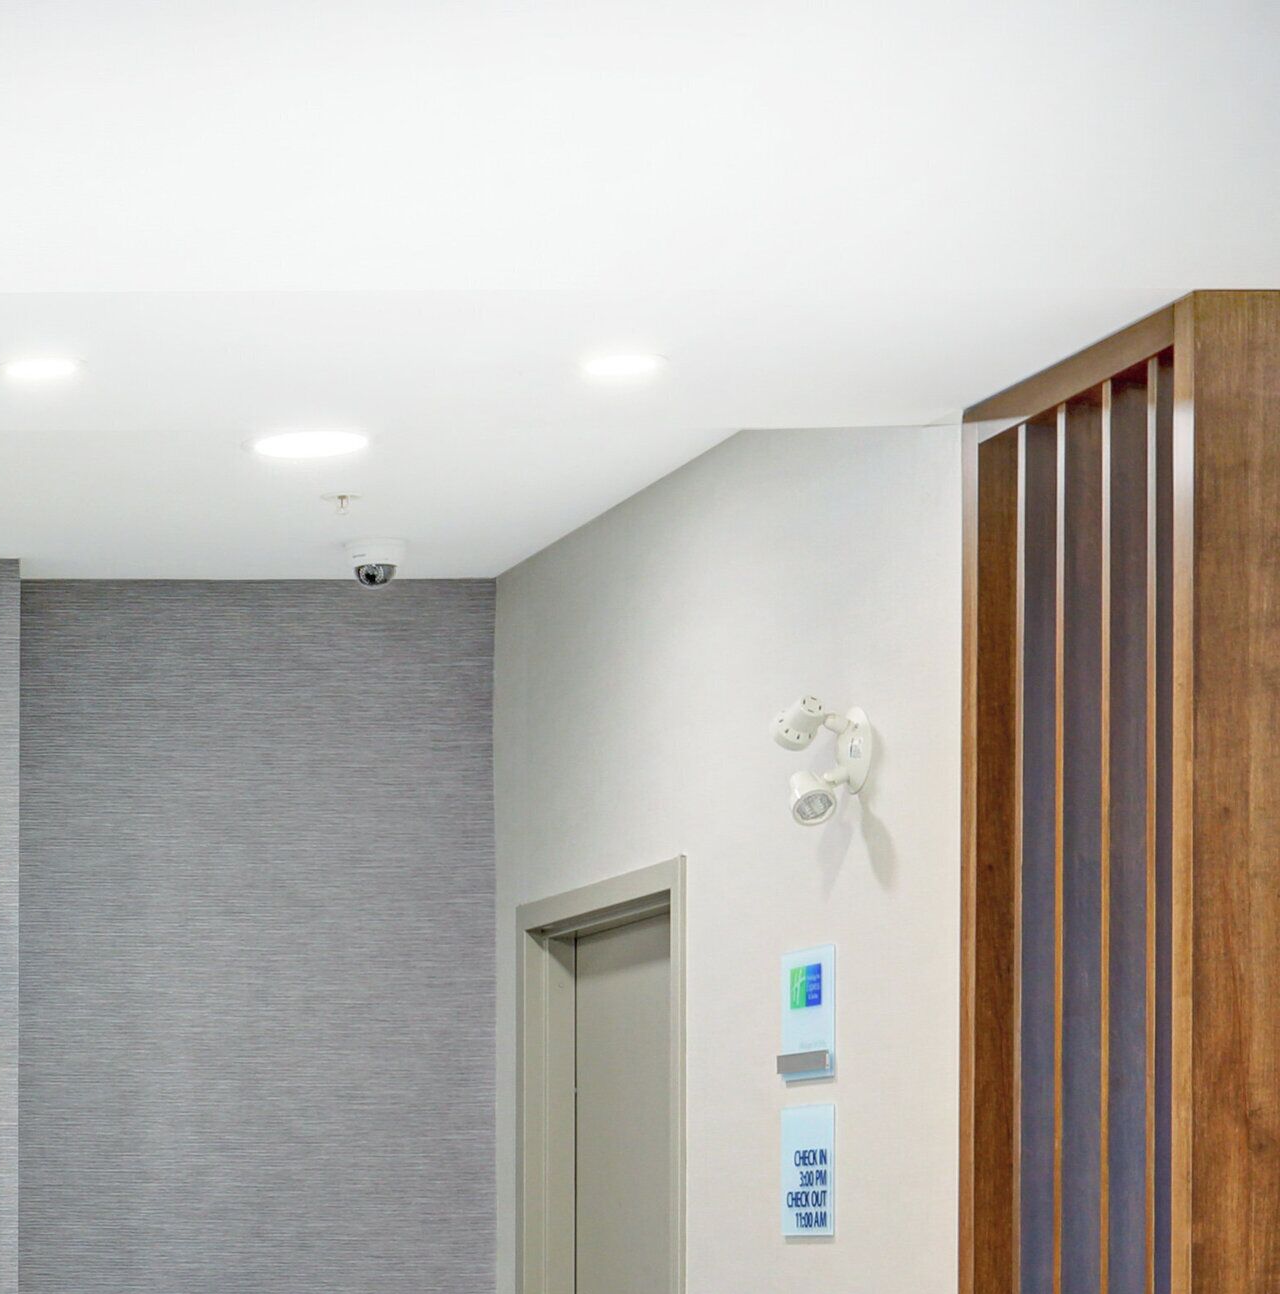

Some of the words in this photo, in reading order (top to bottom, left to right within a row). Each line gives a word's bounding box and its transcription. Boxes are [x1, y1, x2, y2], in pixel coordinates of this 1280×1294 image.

[794, 1149, 818, 1166] CHECK
[819, 1149, 827, 1165] IN
[799, 1170, 814, 1187] 3:00
[815, 1169, 827, 1186] PM
[787, 1191, 810, 1208] CHECK
[811, 1190, 827, 1207] OUT
[795, 1212, 813, 1228] 11:00
[814, 1211, 827, 1227] AM
